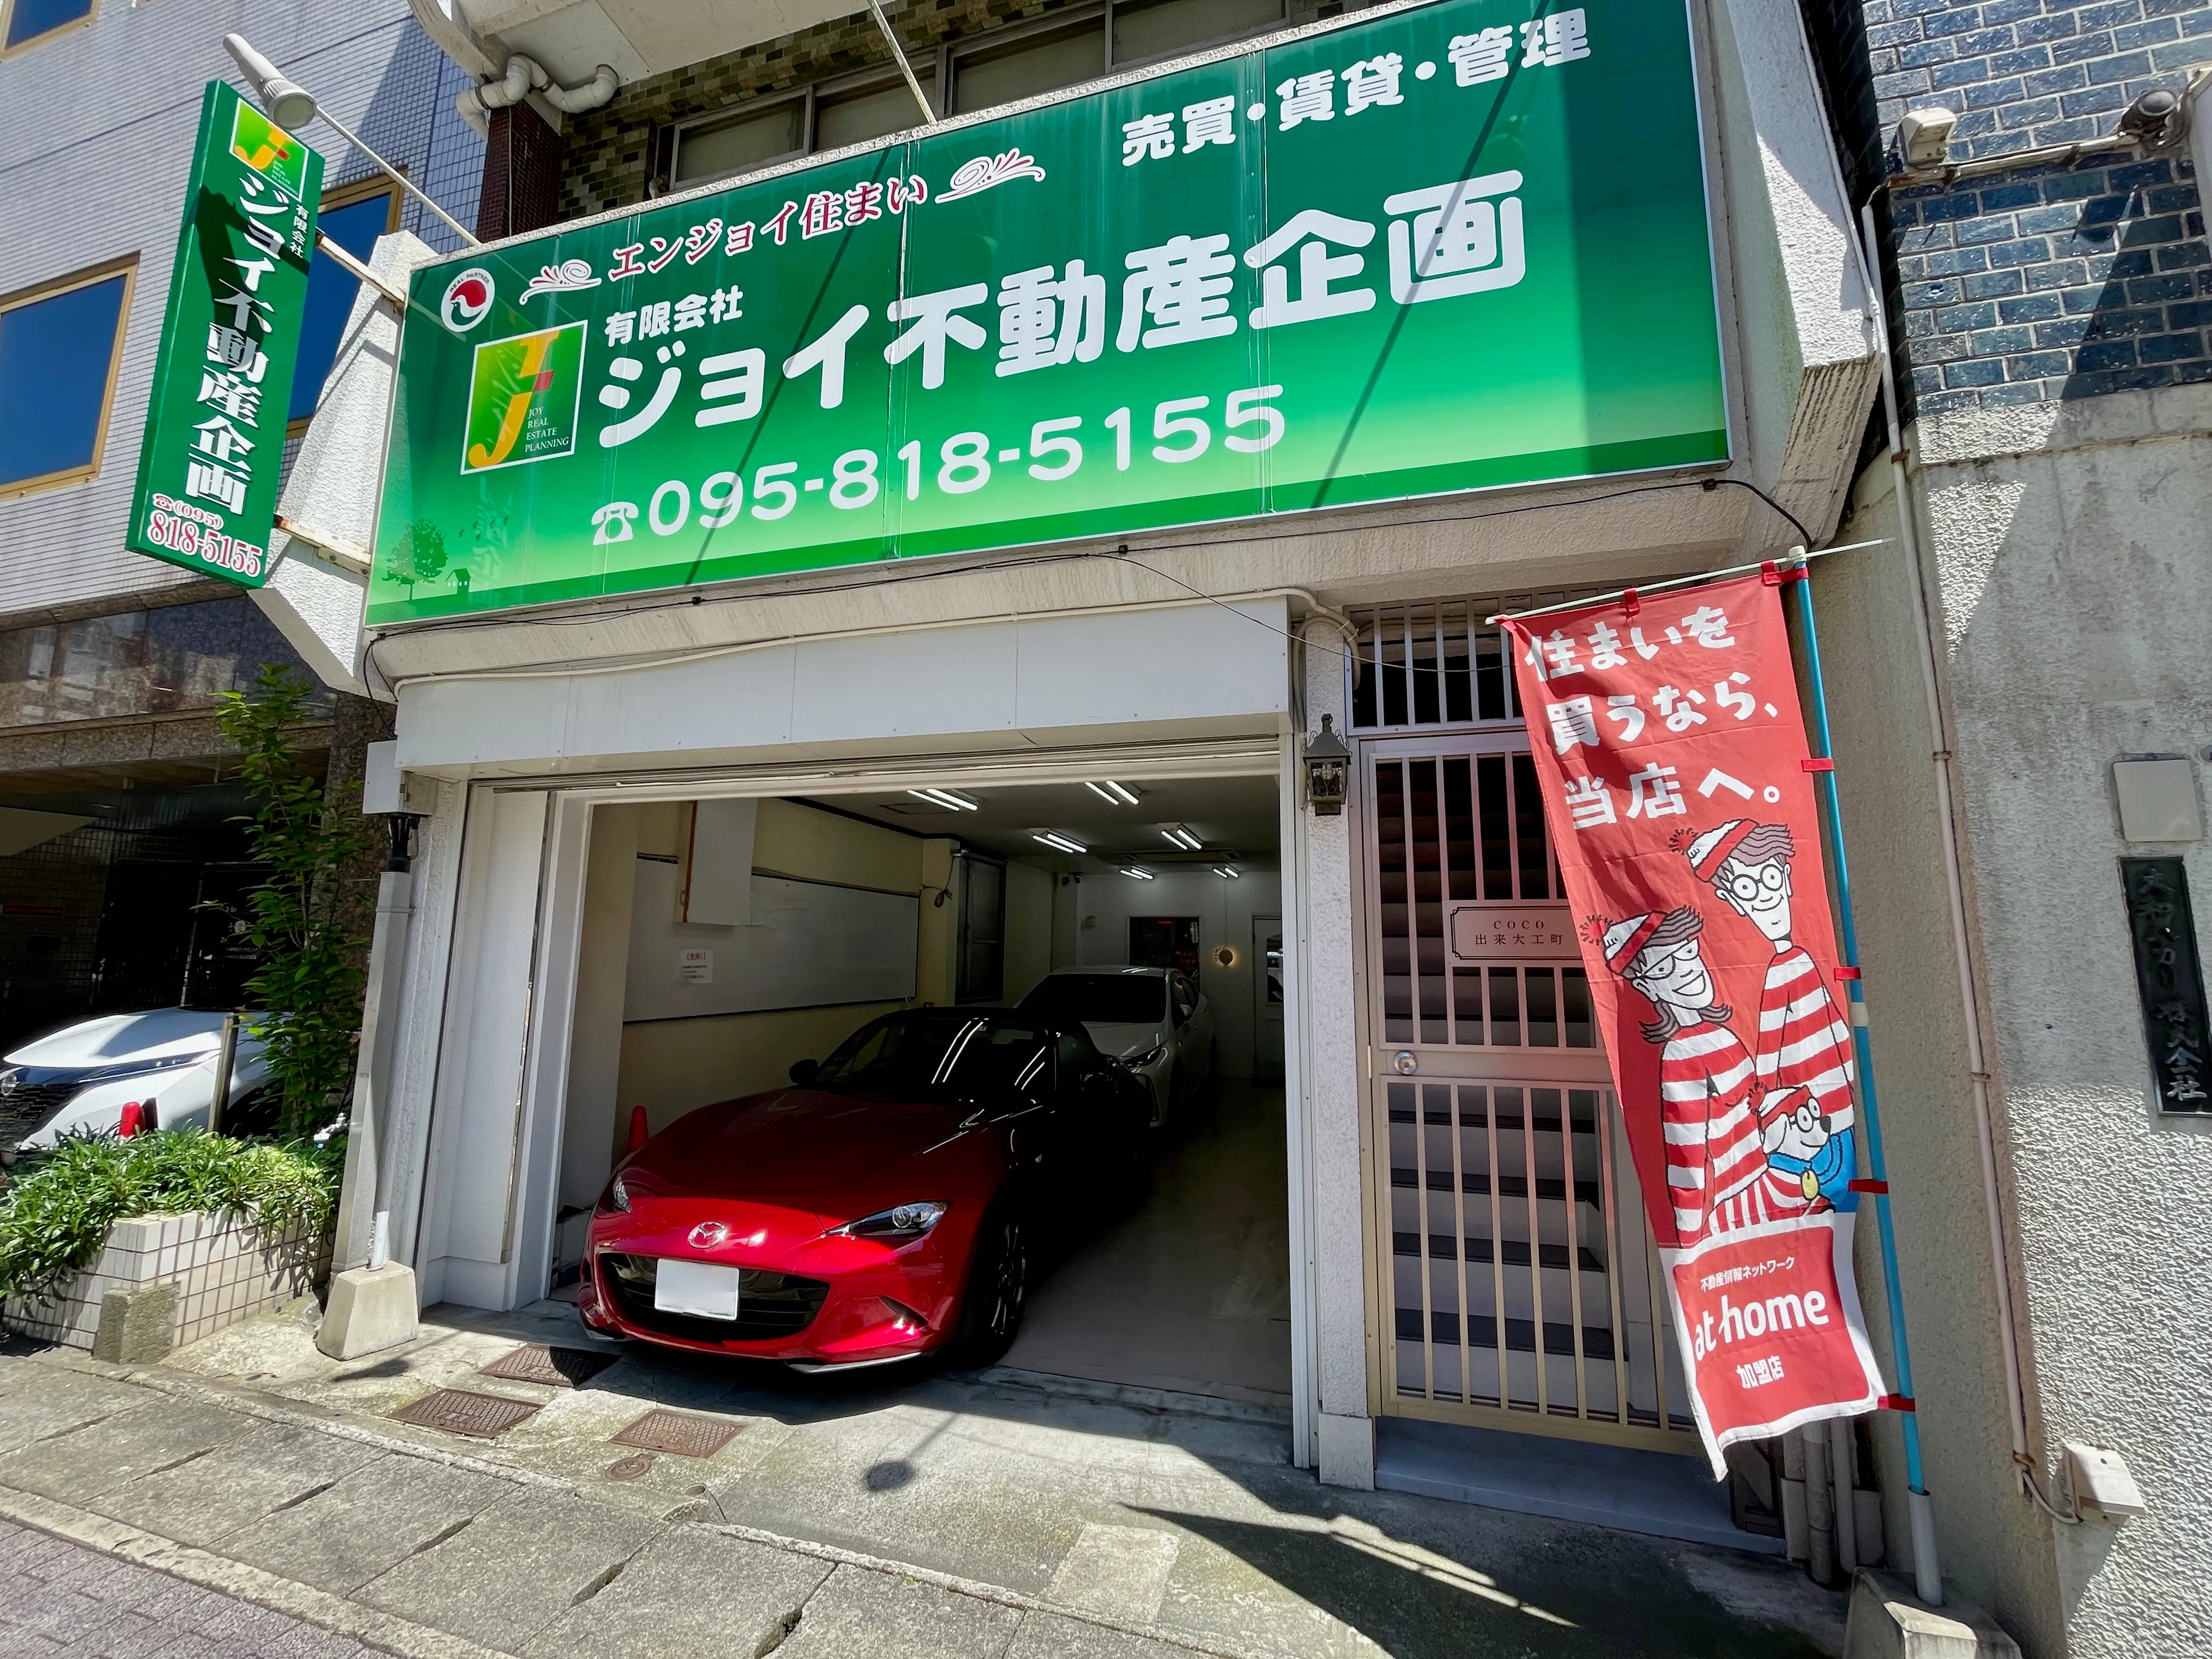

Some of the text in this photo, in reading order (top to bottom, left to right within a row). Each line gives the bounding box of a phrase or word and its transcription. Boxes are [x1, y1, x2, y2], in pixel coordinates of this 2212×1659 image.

[1122, 8, 1592, 167] 売買・賃貸・管理
[289, 204, 309, 258] 有限会社
[609, 173, 927, 282] エンジョイ住まい
[449, 278, 465, 293] REAL
[599, 170, 1526, 448] ジョイ不動産企画
[605, 284, 743, 347] 有限会社
[185, 172, 289, 516] ジョイ不動産企画
[524, 436, 569, 453] PLANNING
[526, 427, 557, 441] ESTATE
[527, 407, 544, 420] JOY
[527, 417, 549, 428] REAL
[648, 384, 1285, 537] 095-818-5155
[148, 510, 263, 577] 818-5155
[1524, 606, 1735, 682] 住まいを
[1546, 671, 1778, 755] 買うなら、
[1565, 761, 1780, 830] 当店へ。
[1475, 934, 1563, 945] 出来大工町
[1493, 920, 1544, 929] COCO
[1700, 1256, 1795, 1292] 不動産情報ネットワーク
[1694, 1290, 1829, 1361] at home
[1736, 1355, 1785, 1390] 加盟店
